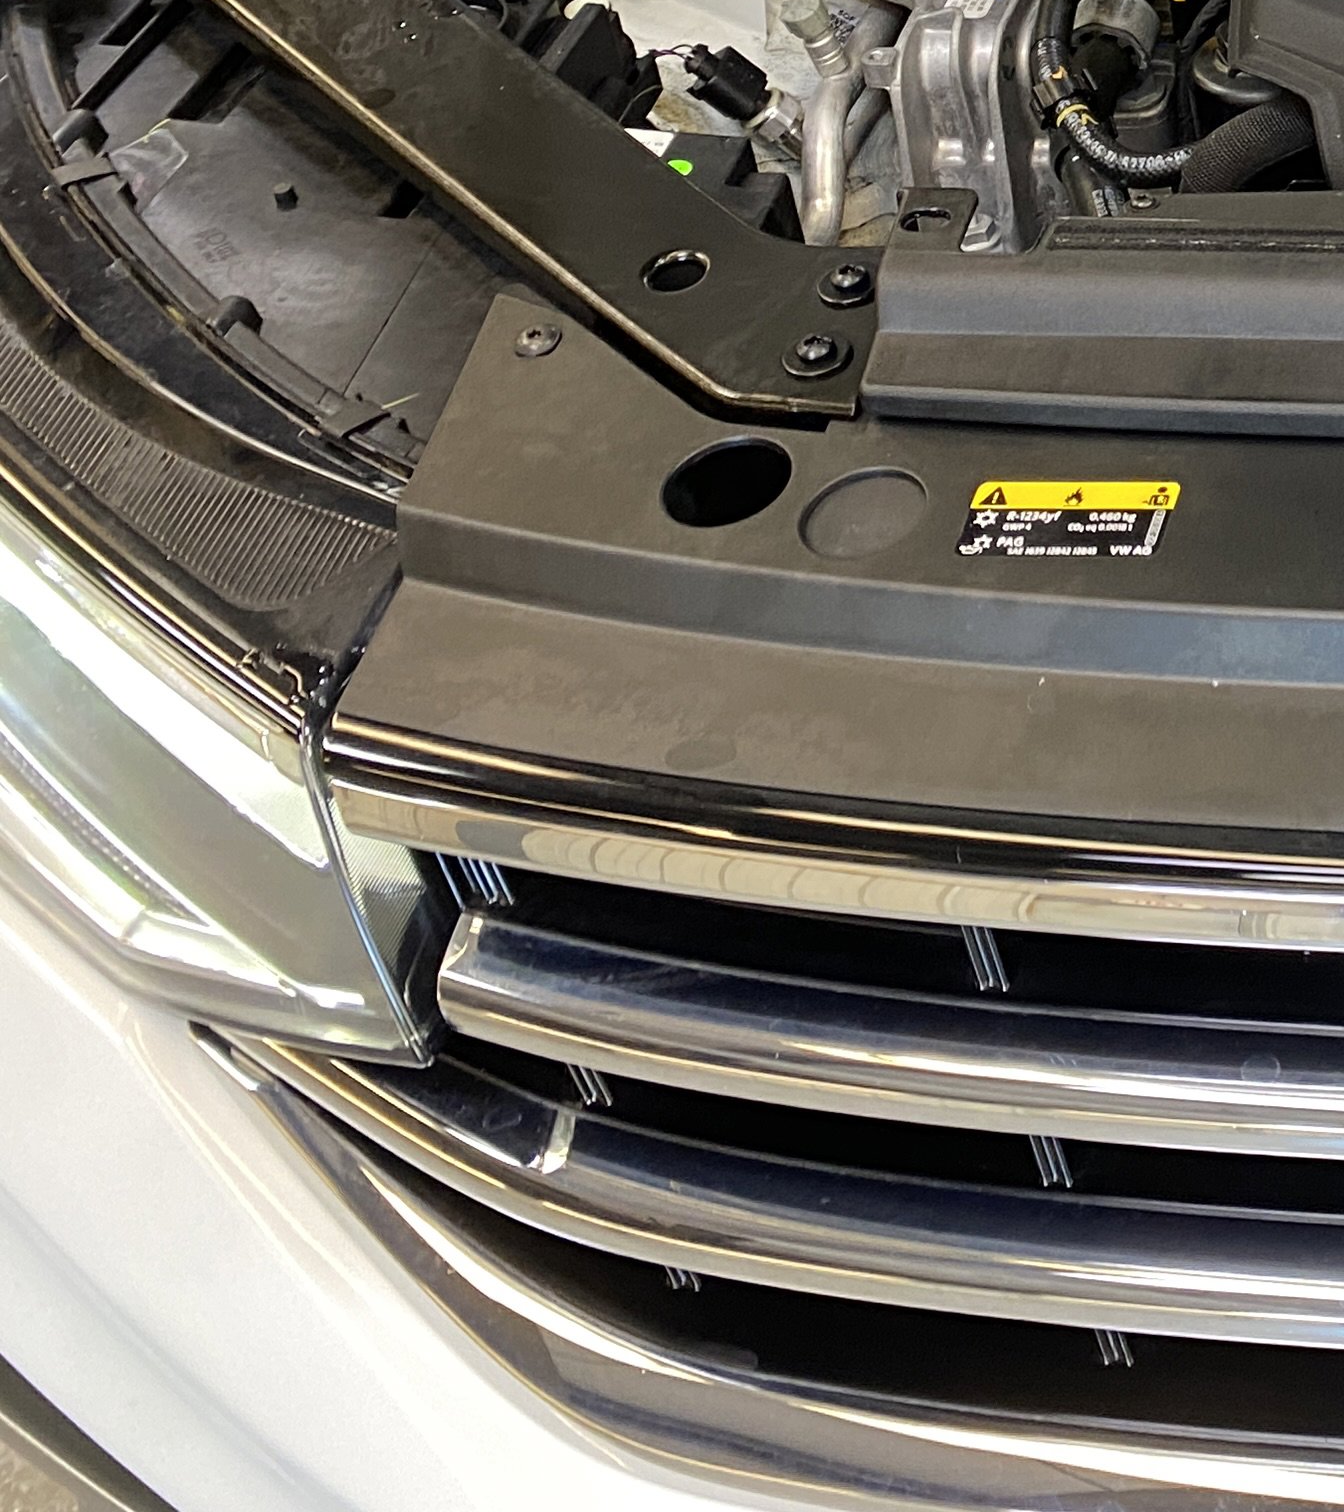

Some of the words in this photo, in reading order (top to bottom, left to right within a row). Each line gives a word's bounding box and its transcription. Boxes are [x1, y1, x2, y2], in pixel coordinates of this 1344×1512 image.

[1006, 510, 1062, 524] R-1234yf
[1122, 512, 1137, 524] kg
[996, 536, 1025, 548] PAG
[1109, 544, 1132, 556] VW
[1132, 544, 1153, 556] AG
